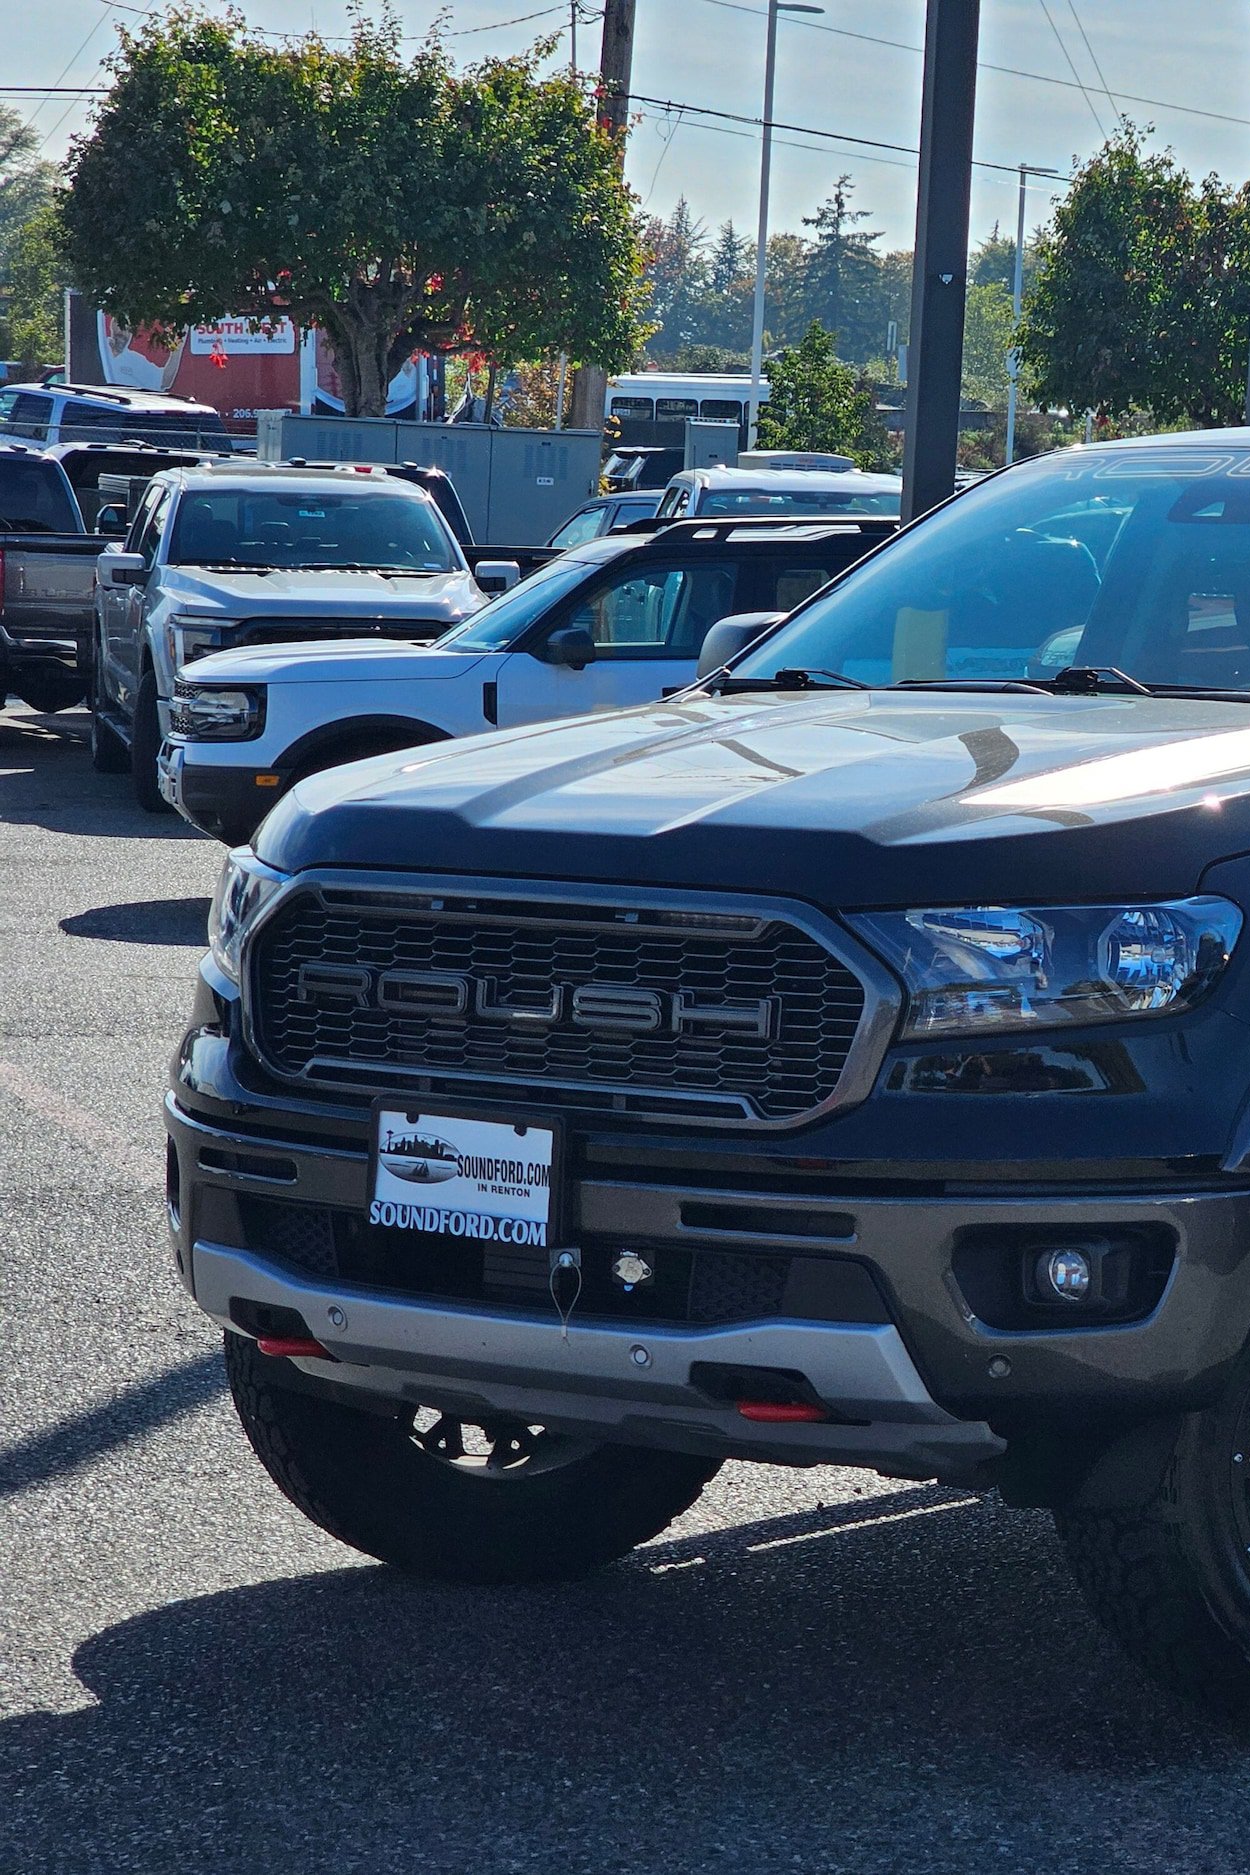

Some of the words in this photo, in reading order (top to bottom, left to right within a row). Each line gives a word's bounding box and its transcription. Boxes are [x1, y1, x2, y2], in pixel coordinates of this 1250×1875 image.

[197, 322, 243, 334] SOUTH
[246, 322, 287, 334] EST
[299, 963, 782, 1039] ROUSH
[457, 1154, 550, 1188] SOUNDFORD.COM
[477, 1183, 488, 1193] IN
[491, 1184, 531, 1198] RENTON
[369, 1200, 547, 1247] SOUNDFORD.COM
